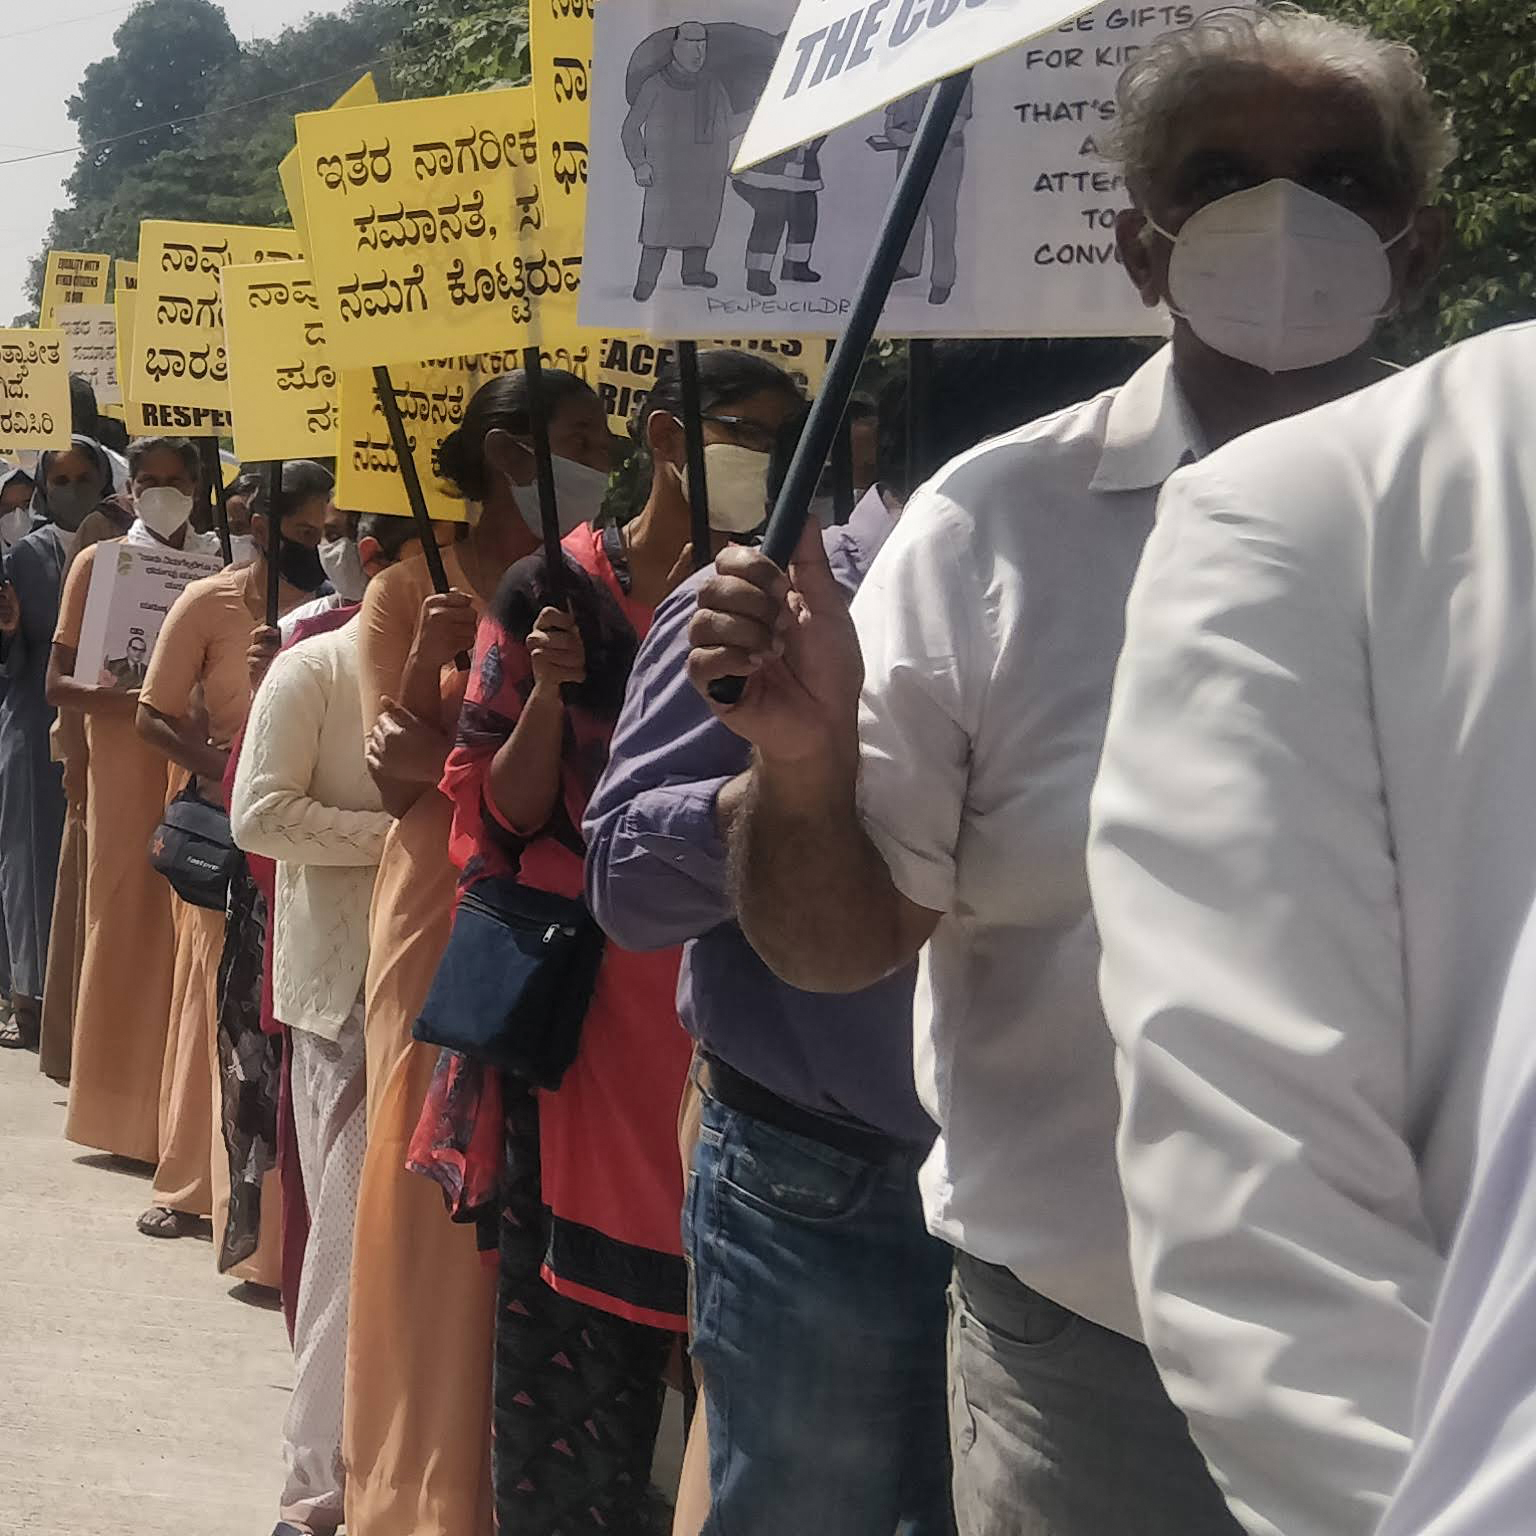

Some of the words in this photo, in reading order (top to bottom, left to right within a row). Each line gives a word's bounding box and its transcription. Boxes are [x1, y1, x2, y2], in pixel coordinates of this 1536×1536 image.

[1058, 12, 1094, 33] EE
[1106, 5, 1194, 29] GIFTS
[1026, 47, 1083, 69] FOR
[1014, 99, 1116, 123] THAT'S
[316, 137, 392, 196] ಇತರ
[413, 120, 538, 181] ನಾಗರೀಕ
[1034, 171, 1127, 193] ATTE
[1034, 244, 1119, 265] CONV
[338, 264, 429, 323] ನಮಗೆ
[707, 297, 852, 314] PENPENCILDR
[142, 403, 232, 427] RESPE
